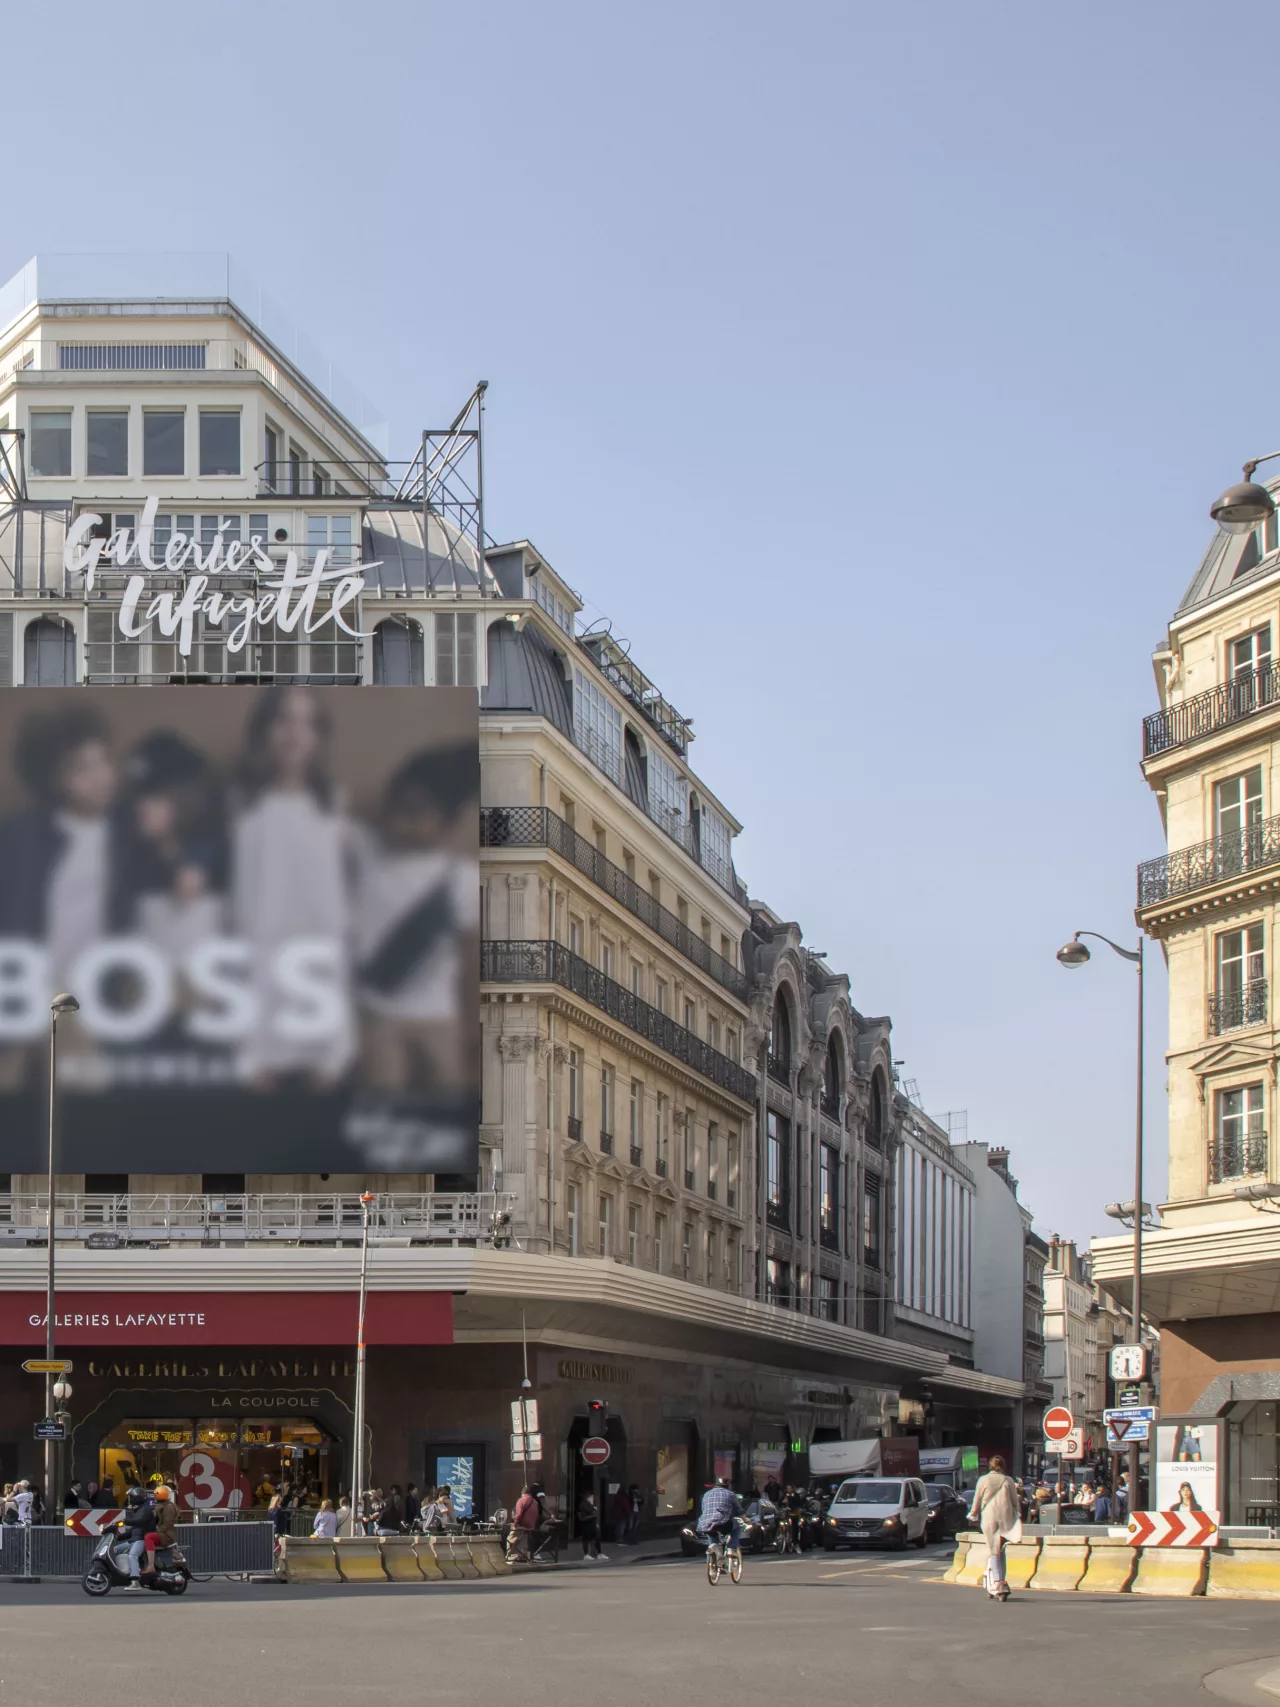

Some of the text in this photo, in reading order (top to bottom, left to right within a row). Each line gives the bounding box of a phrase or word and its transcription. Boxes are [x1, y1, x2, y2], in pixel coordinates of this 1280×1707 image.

[63, 495, 274, 591] Galeries
[118, 549, 385, 656] Lafayette
[28, 1313, 206, 1326] GALERIES LAFAYETTE
[88, 1360, 209, 1377] GALERIES
[211, 1397, 320, 1407] LA COUPOLE
